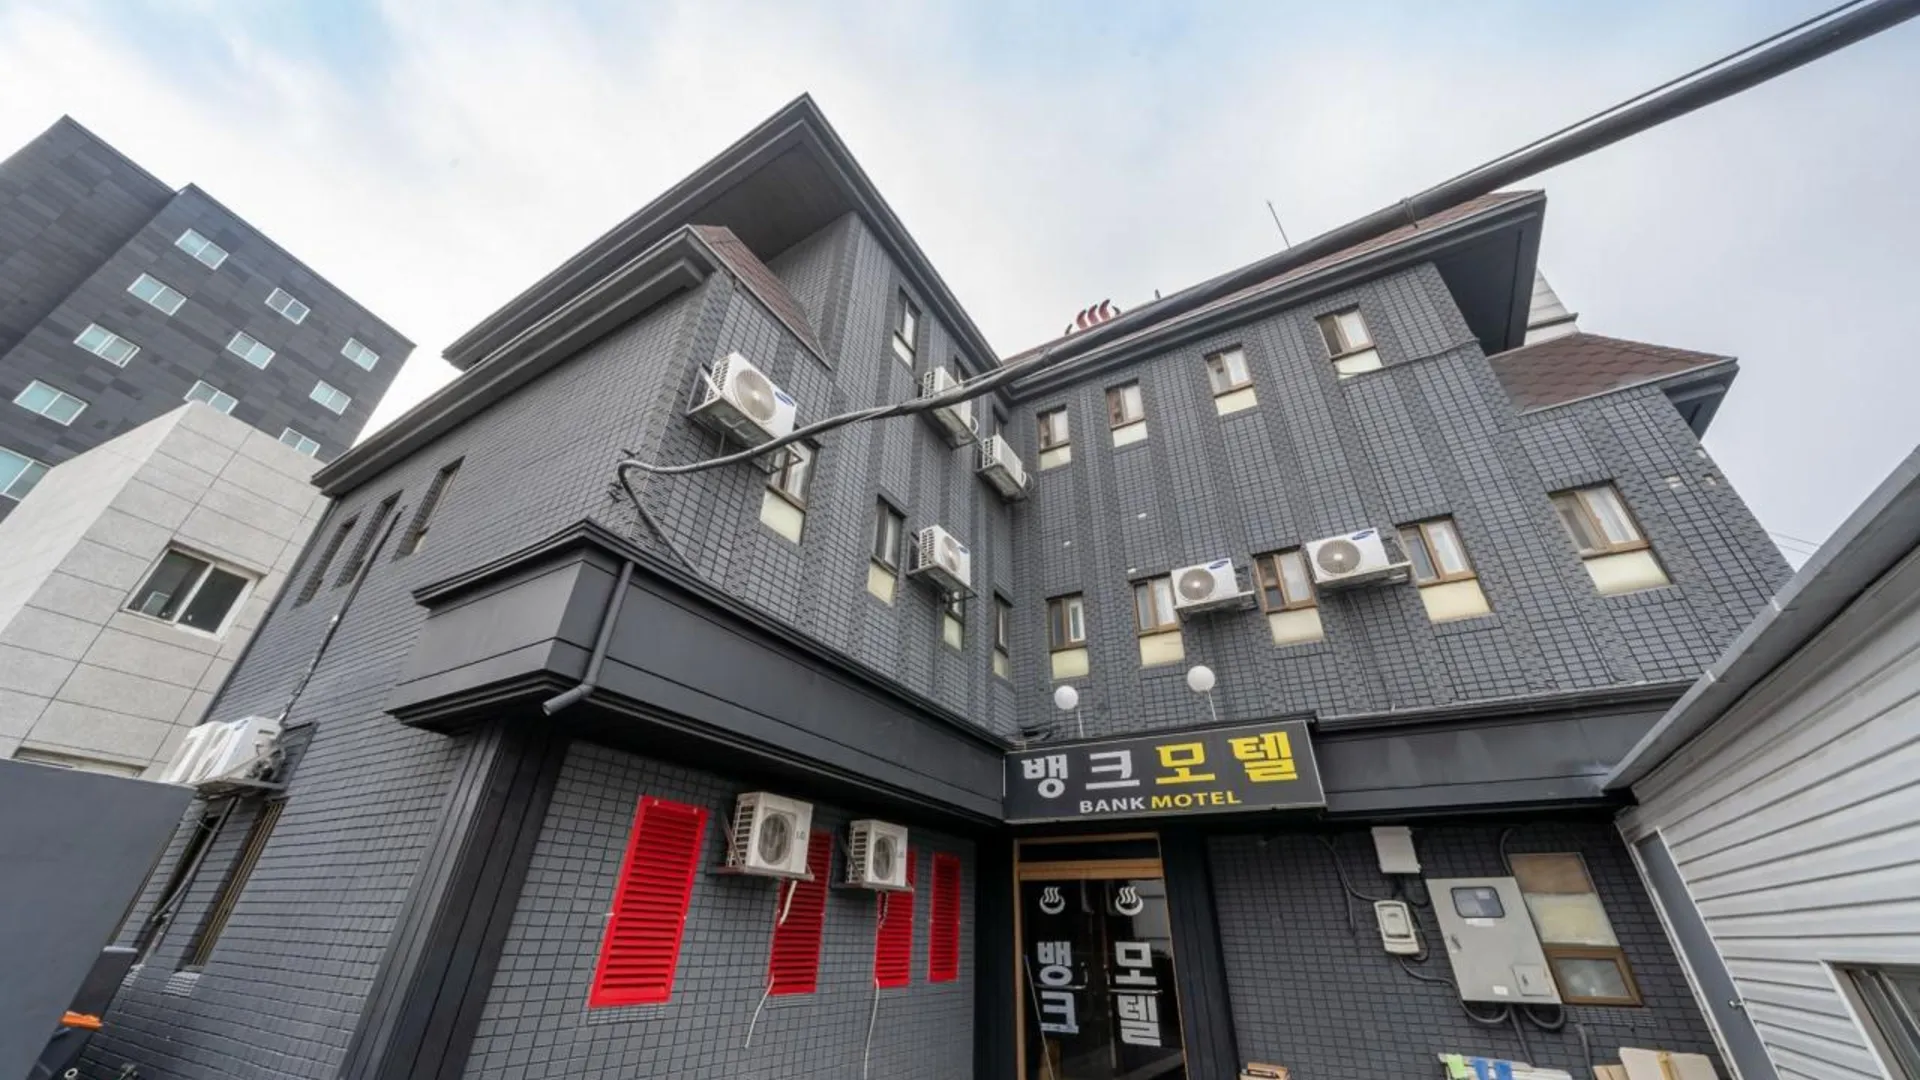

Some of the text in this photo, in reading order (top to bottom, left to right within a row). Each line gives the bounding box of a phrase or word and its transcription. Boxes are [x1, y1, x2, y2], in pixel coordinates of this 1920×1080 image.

[1020, 731, 1298, 799] 뱅크 모텔
[1080, 791, 1242, 813] BANK MOTEL
[1037, 941, 1079, 1034] 뱅크
[1115, 941, 1162, 1047] 모텔
